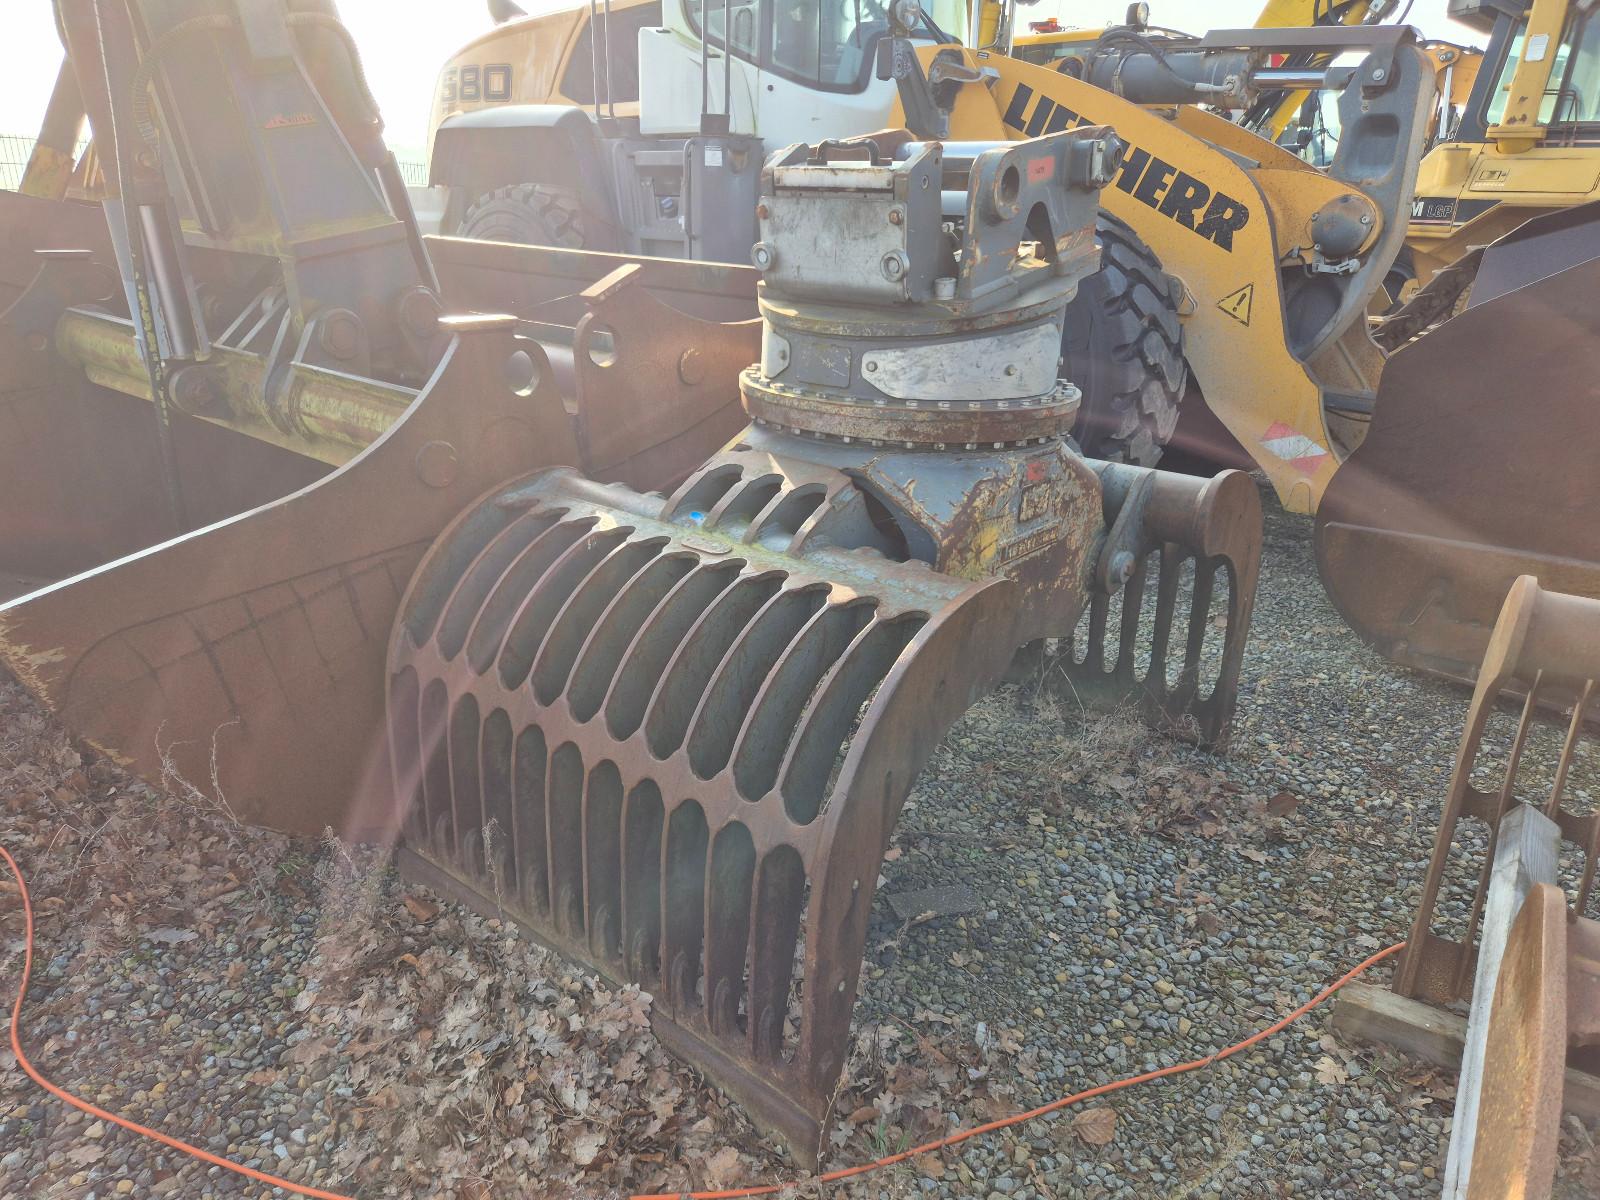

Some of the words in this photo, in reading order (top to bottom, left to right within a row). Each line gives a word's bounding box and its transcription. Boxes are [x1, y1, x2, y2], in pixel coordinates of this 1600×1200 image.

[440, 64, 513, 103] 580
[1003, 82, 1250, 253] LIEHERR
[1427, 204, 1453, 218] LGP
